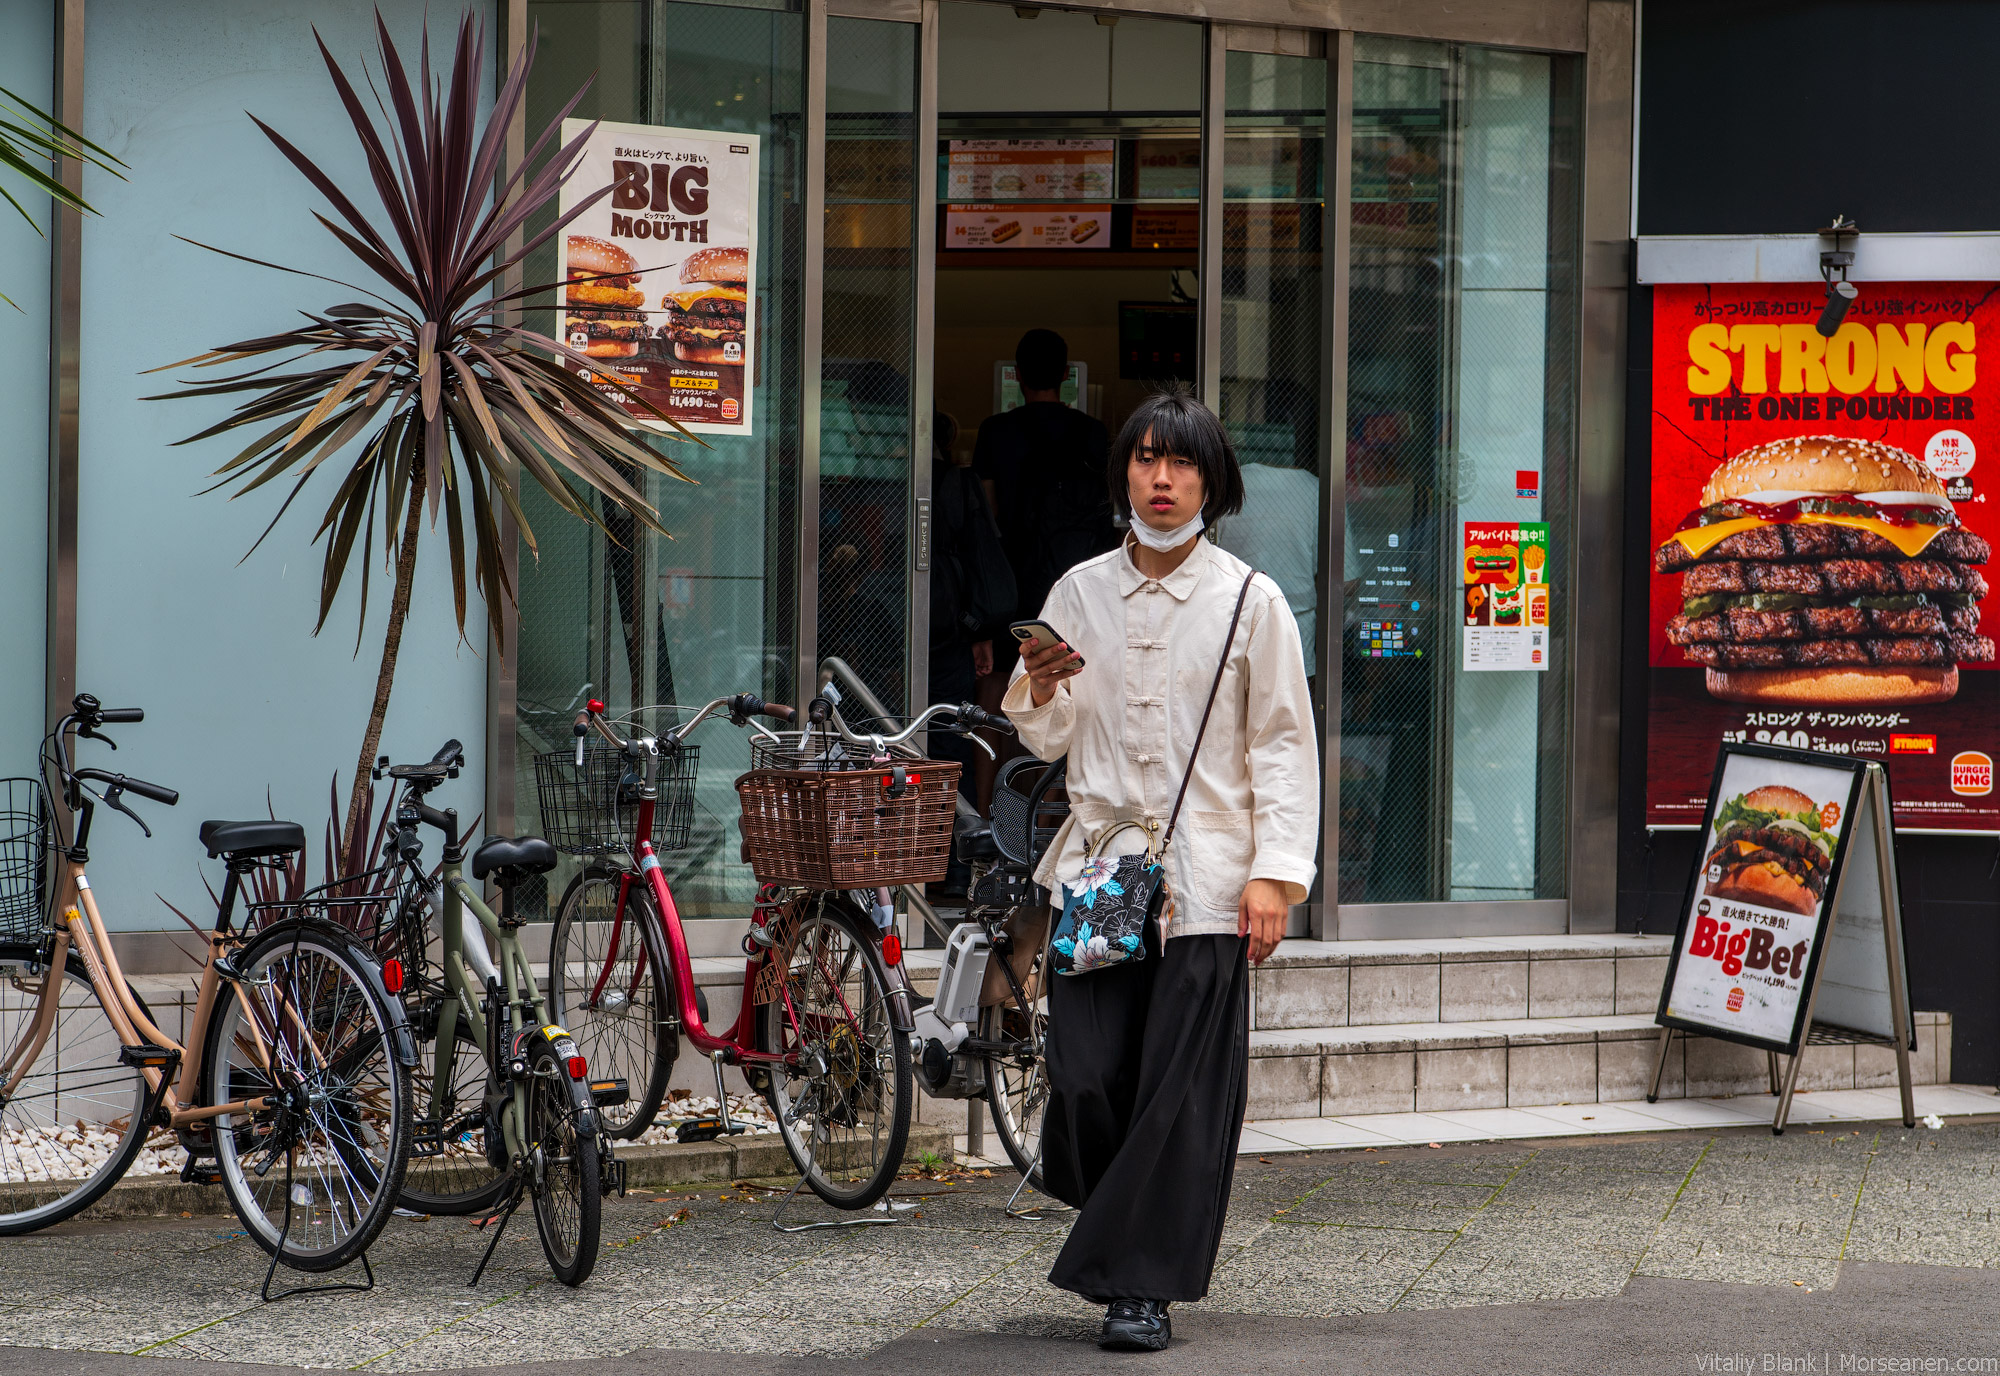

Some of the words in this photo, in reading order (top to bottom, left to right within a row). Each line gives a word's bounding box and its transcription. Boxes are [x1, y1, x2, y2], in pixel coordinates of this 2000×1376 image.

[614, 147, 710, 164] 直火はビッグで、より旨い。
[952, 154, 1000, 162] CHICKEN
[612, 160, 709, 215] BIG
[644, 212, 676, 221] ビッグマウス
[611, 212, 708, 244] MOUTH
[1687, 321, 1977, 394] STRONG
[1688, 396, 1752, 420] THE
[1758, 396, 1820, 420] ONE
[1826, 396, 1975, 420] POUNDER
[1933, 449, 1968, 458] スパイシー
[1745, 711, 1804, 726] ストロング
[1806, 712, 1910, 728] ザ・ワンパウンダー
[1894, 738, 1932, 750] STRONG
[1953, 765, 1991, 775] BURGER
[1953, 774, 1991, 786] KING
[1722, 906, 1790, 930] 直火焼きで大勝負!
[78, 946, 99, 984] CASTANET
[1727, 1000, 1743, 1009] KING
